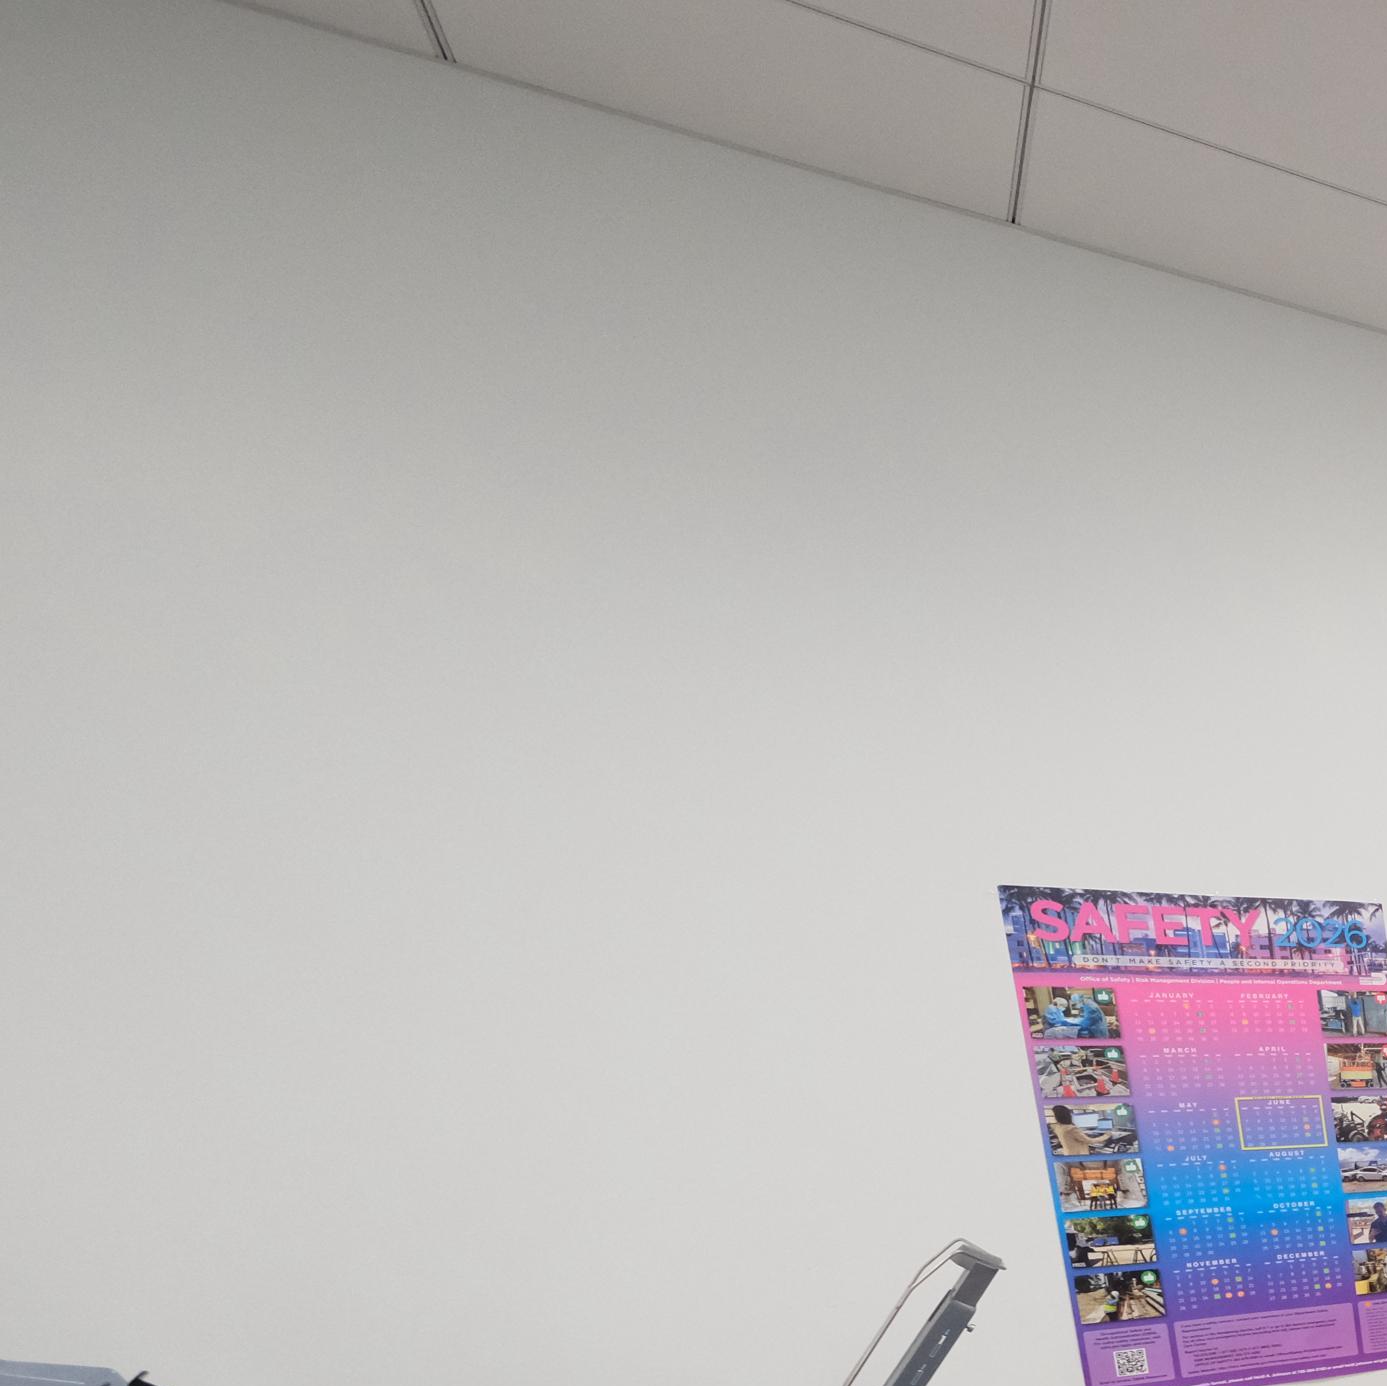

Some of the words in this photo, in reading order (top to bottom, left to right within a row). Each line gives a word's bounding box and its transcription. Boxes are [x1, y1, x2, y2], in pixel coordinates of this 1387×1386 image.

[1030, 899, 1261, 948] SAFETY
[1274, 917, 1367, 948] 2026
[1082, 956, 1121, 964] DON'T
[1168, 959, 1215, 967] SAFETY
[1232, 960, 1277, 968] SECOND
[1273, 1201, 1316, 1209] OCTOBER
[1176, 1207, 1232, 1216] SEPTEMBER
[1277, 1251, 1325, 1260] DECEMBER
[1186, 1258, 1237, 1268] NOVEMBER
